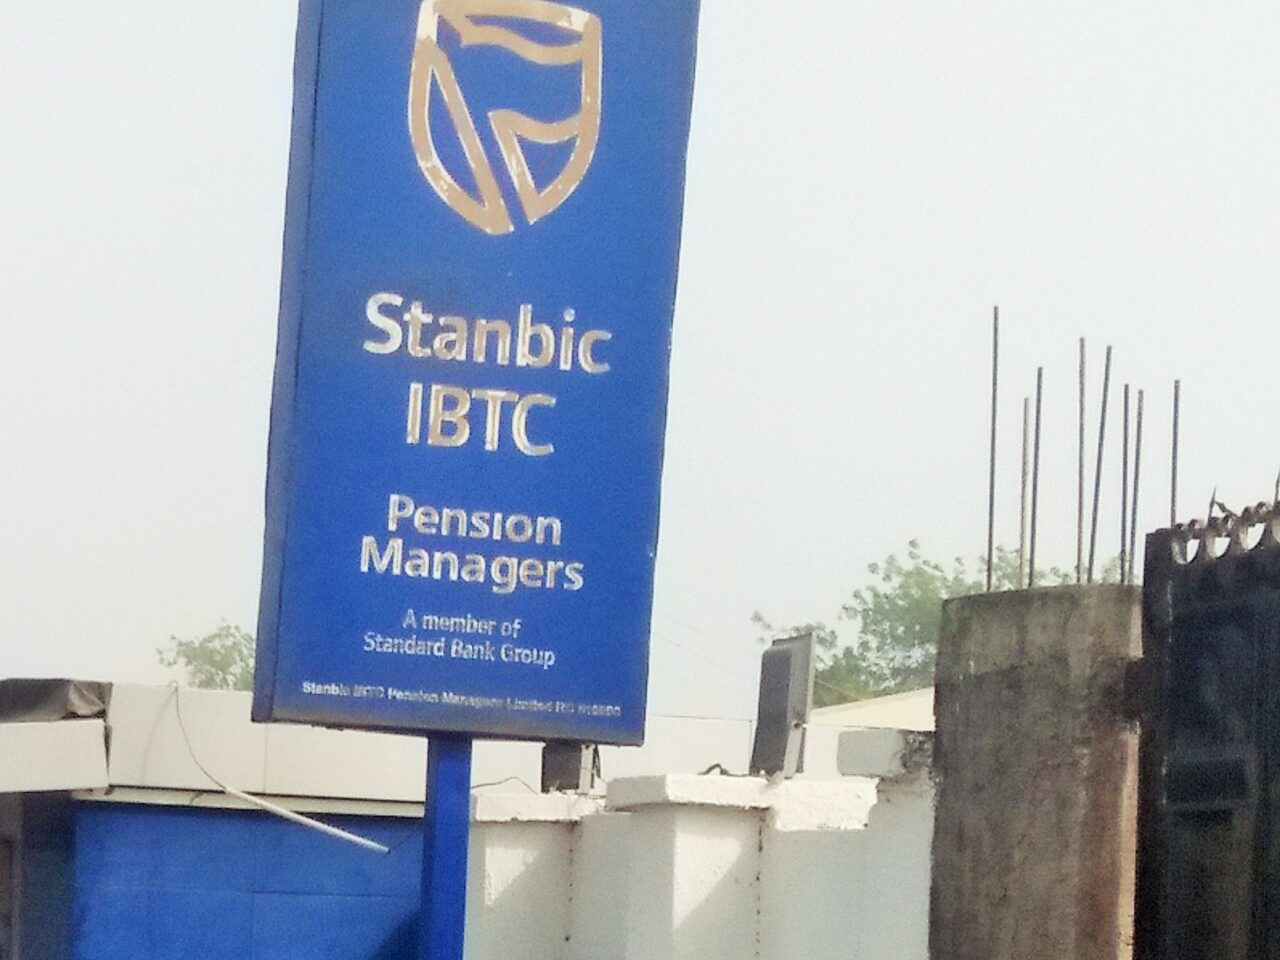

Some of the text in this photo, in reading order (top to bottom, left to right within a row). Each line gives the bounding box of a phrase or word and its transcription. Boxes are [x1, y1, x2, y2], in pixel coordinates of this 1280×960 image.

[363, 292, 612, 374] Stanbic
[406, 382, 557, 456] IBTC
[387, 493, 562, 546] Pension
[360, 535, 584, 594] Managers
[402, 608, 522, 638] A member of
[364, 631, 557, 670] Standard Bank Group
[302, 680, 351, 697] Stanbic
